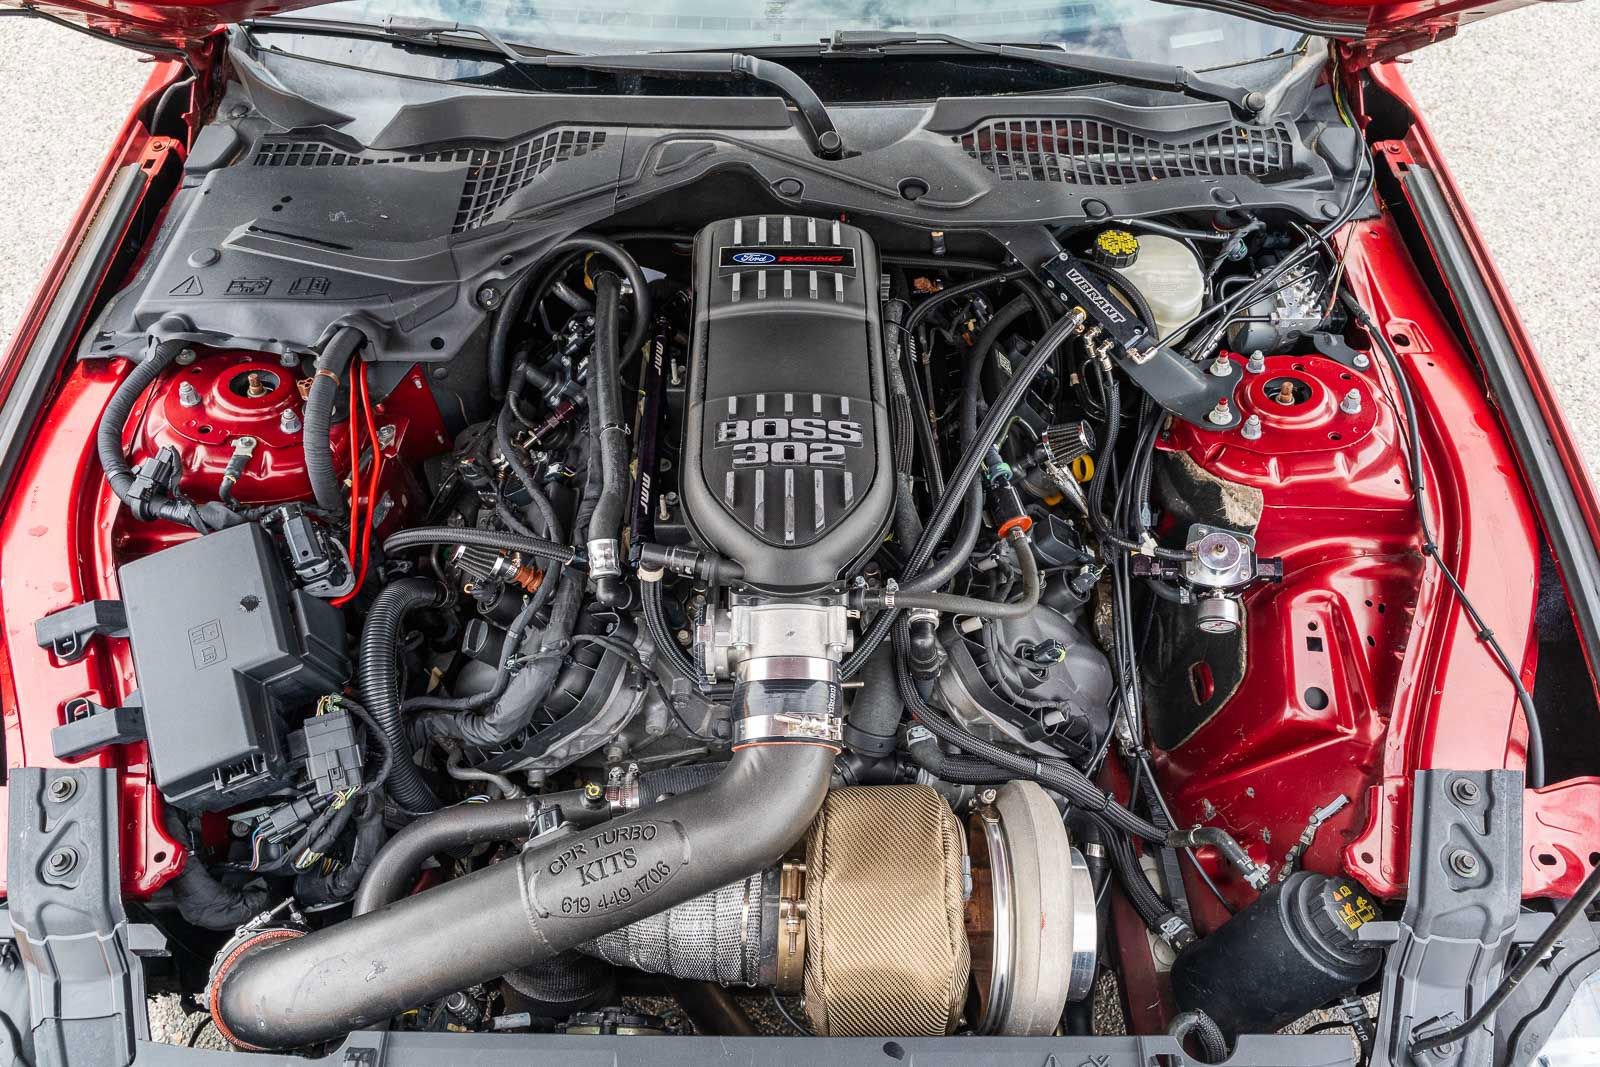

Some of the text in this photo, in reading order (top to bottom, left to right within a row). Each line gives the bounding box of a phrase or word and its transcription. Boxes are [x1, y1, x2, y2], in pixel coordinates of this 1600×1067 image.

[741, 253, 843, 263] Ford RACING
[1065, 268, 1127, 323] VIBRANT
[716, 418, 863, 443] BOSS
[732, 442, 846, 466] 302
[549, 824, 657, 876] CPR TURBO
[576, 847, 638, 887] KITS
[561, 860, 672, 914] 619 449 1706
